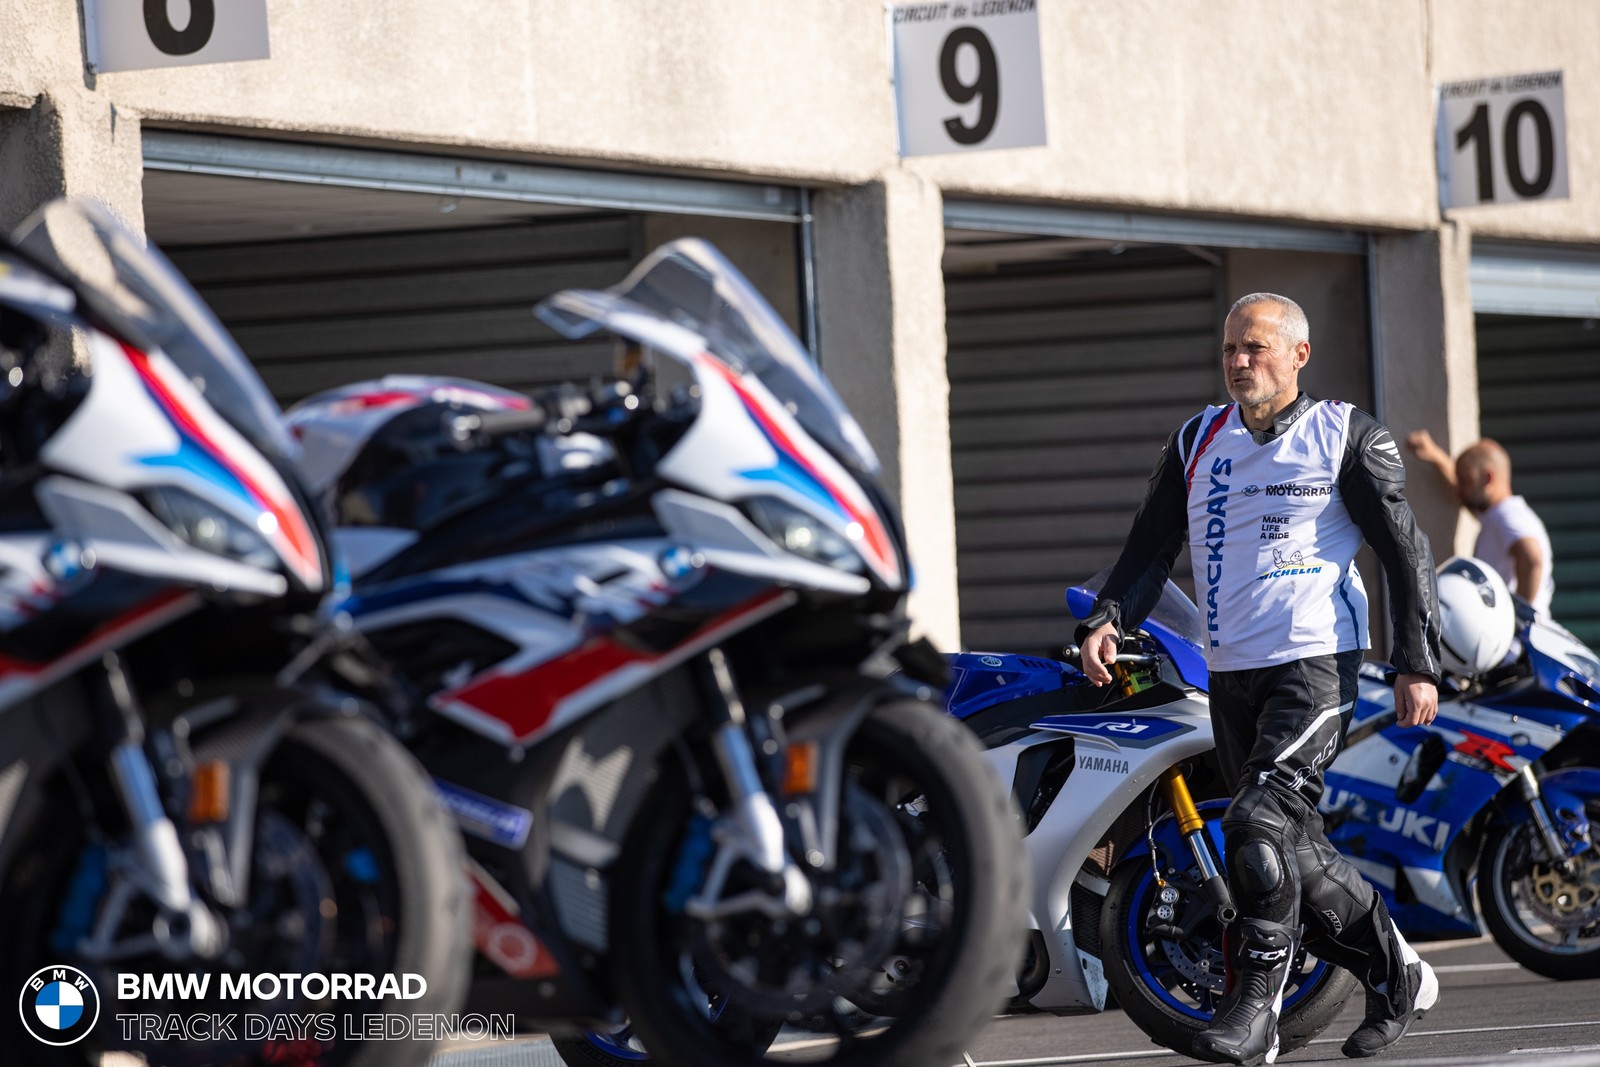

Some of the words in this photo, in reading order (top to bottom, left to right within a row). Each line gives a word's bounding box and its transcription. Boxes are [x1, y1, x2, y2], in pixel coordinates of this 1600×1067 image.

[940, 26, 999, 146] 9
[1456, 99, 1554, 201] 10
[1265, 486, 1333, 497] MOTORRAD
[1262, 516, 1290, 525] MAKE
[1261, 524, 1281, 532] LIFE
[1260, 532, 1267, 540] A
[1268, 532, 1289, 540] RIDE
[1206, 456, 1232, 653] TRACKDAYS
[1256, 566, 1322, 580] MICHELIN
[1079, 755, 1129, 774] YAMAHA
[1318, 784, 1450, 851] UZUKI
[1248, 946, 1288, 960] TCX
